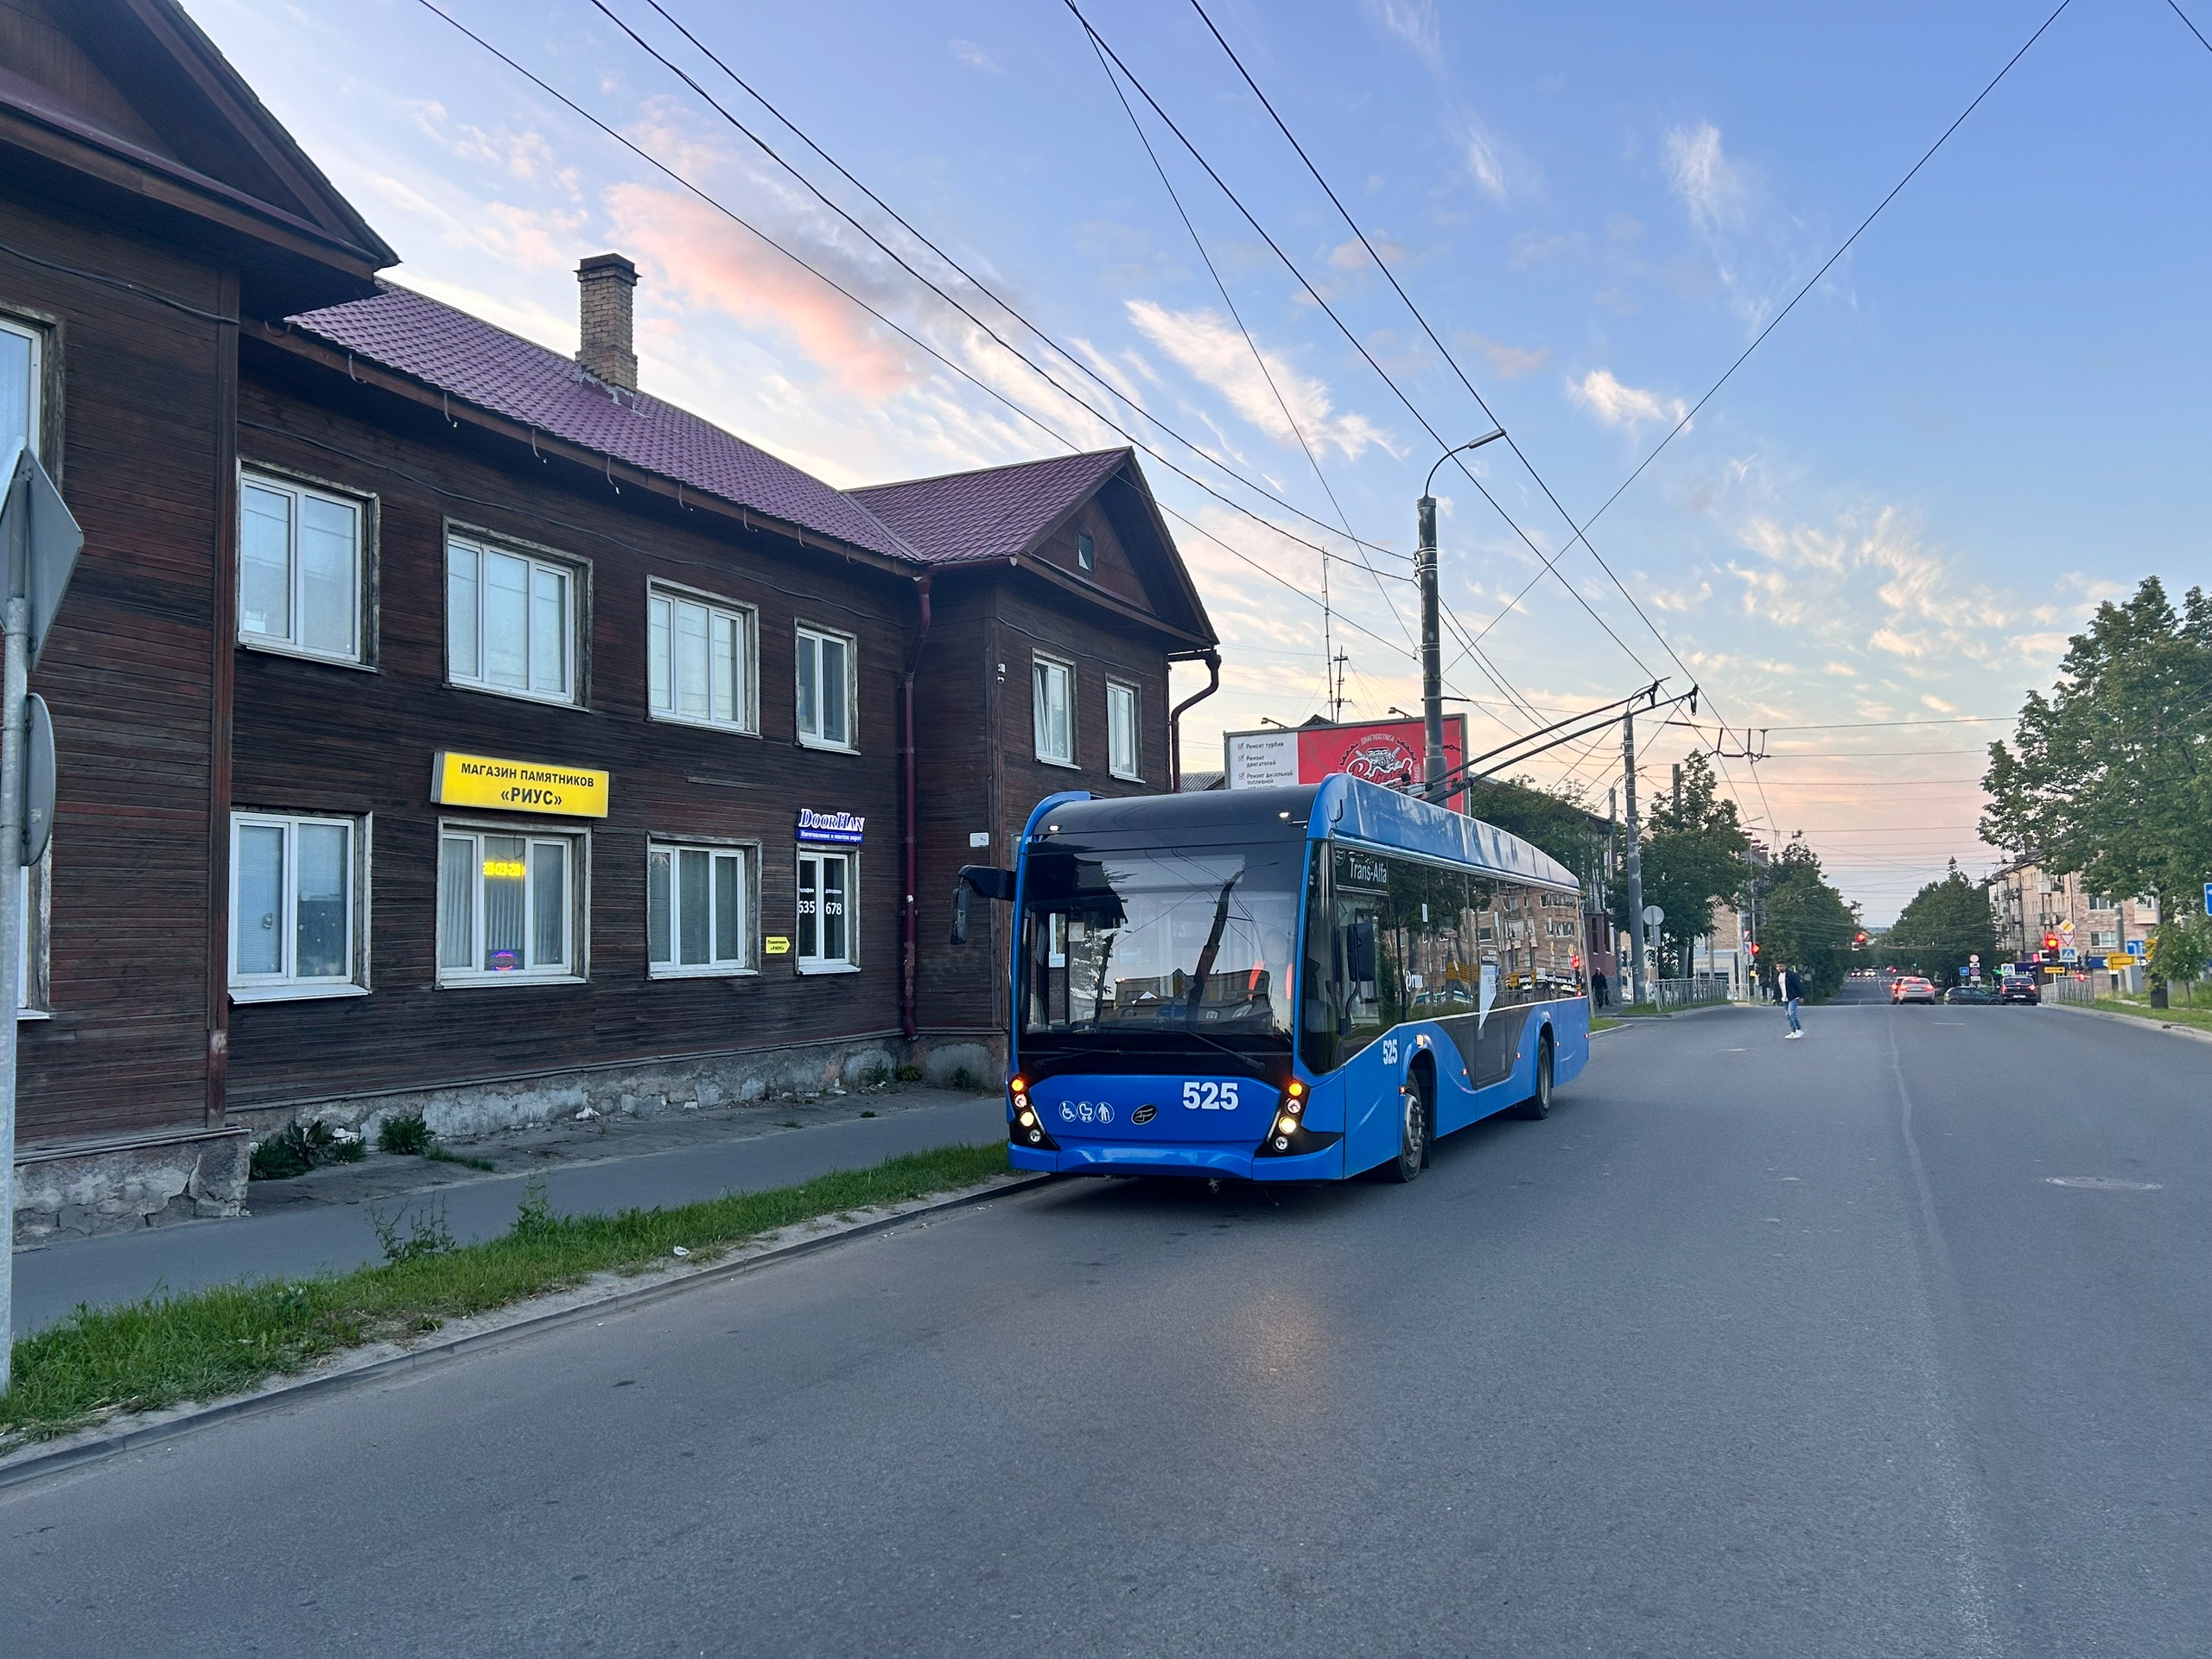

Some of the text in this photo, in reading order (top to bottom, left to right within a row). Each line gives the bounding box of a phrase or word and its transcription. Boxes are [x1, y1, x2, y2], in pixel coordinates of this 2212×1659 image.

[461, 763, 594, 787] МАГАЗИН ПАМЯТНИКОВ
[501, 787, 563, 805] «РИУС»
[1350, 857, 1387, 883] Trans-Alfa
[798, 900, 842, 915] 635 678
[1382, 1039, 1398, 1065] 525
[1182, 1081, 1239, 1110] 525
